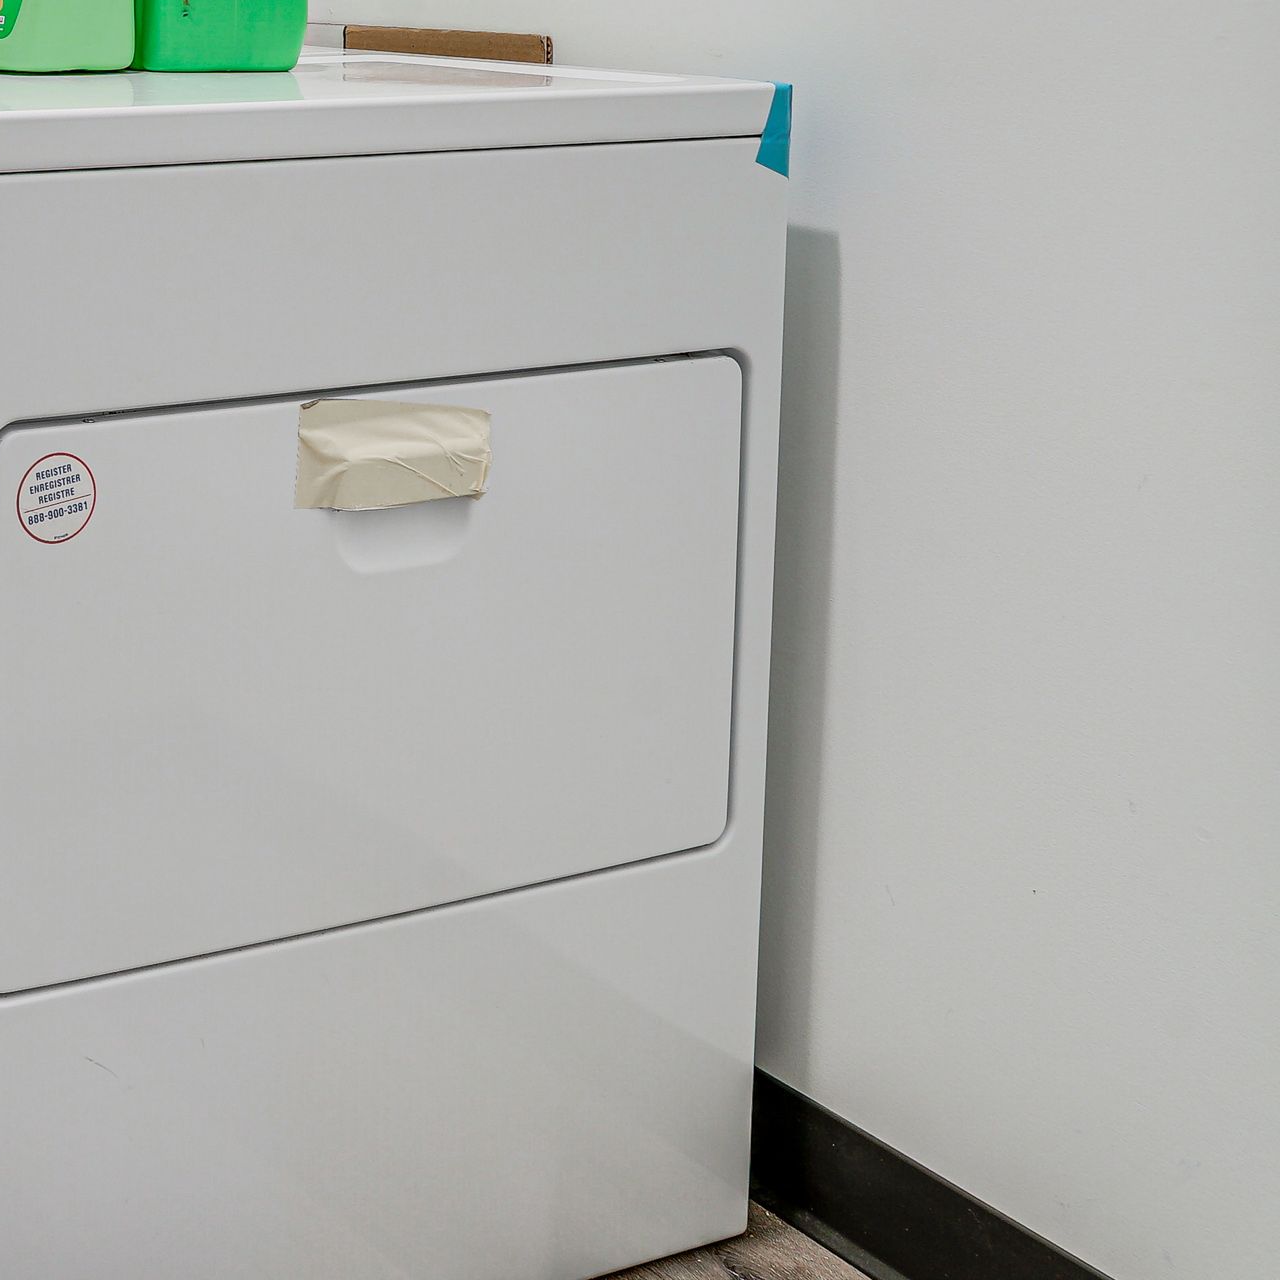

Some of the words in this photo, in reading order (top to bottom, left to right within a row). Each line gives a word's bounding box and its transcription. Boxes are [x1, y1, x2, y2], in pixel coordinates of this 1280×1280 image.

[36, 464, 72, 481] REGISTER
[29, 474, 81, 494] ENREGISTRER
[38, 487, 75, 504] REGISTRE
[28, 501, 88, 525] 888-900-3381
